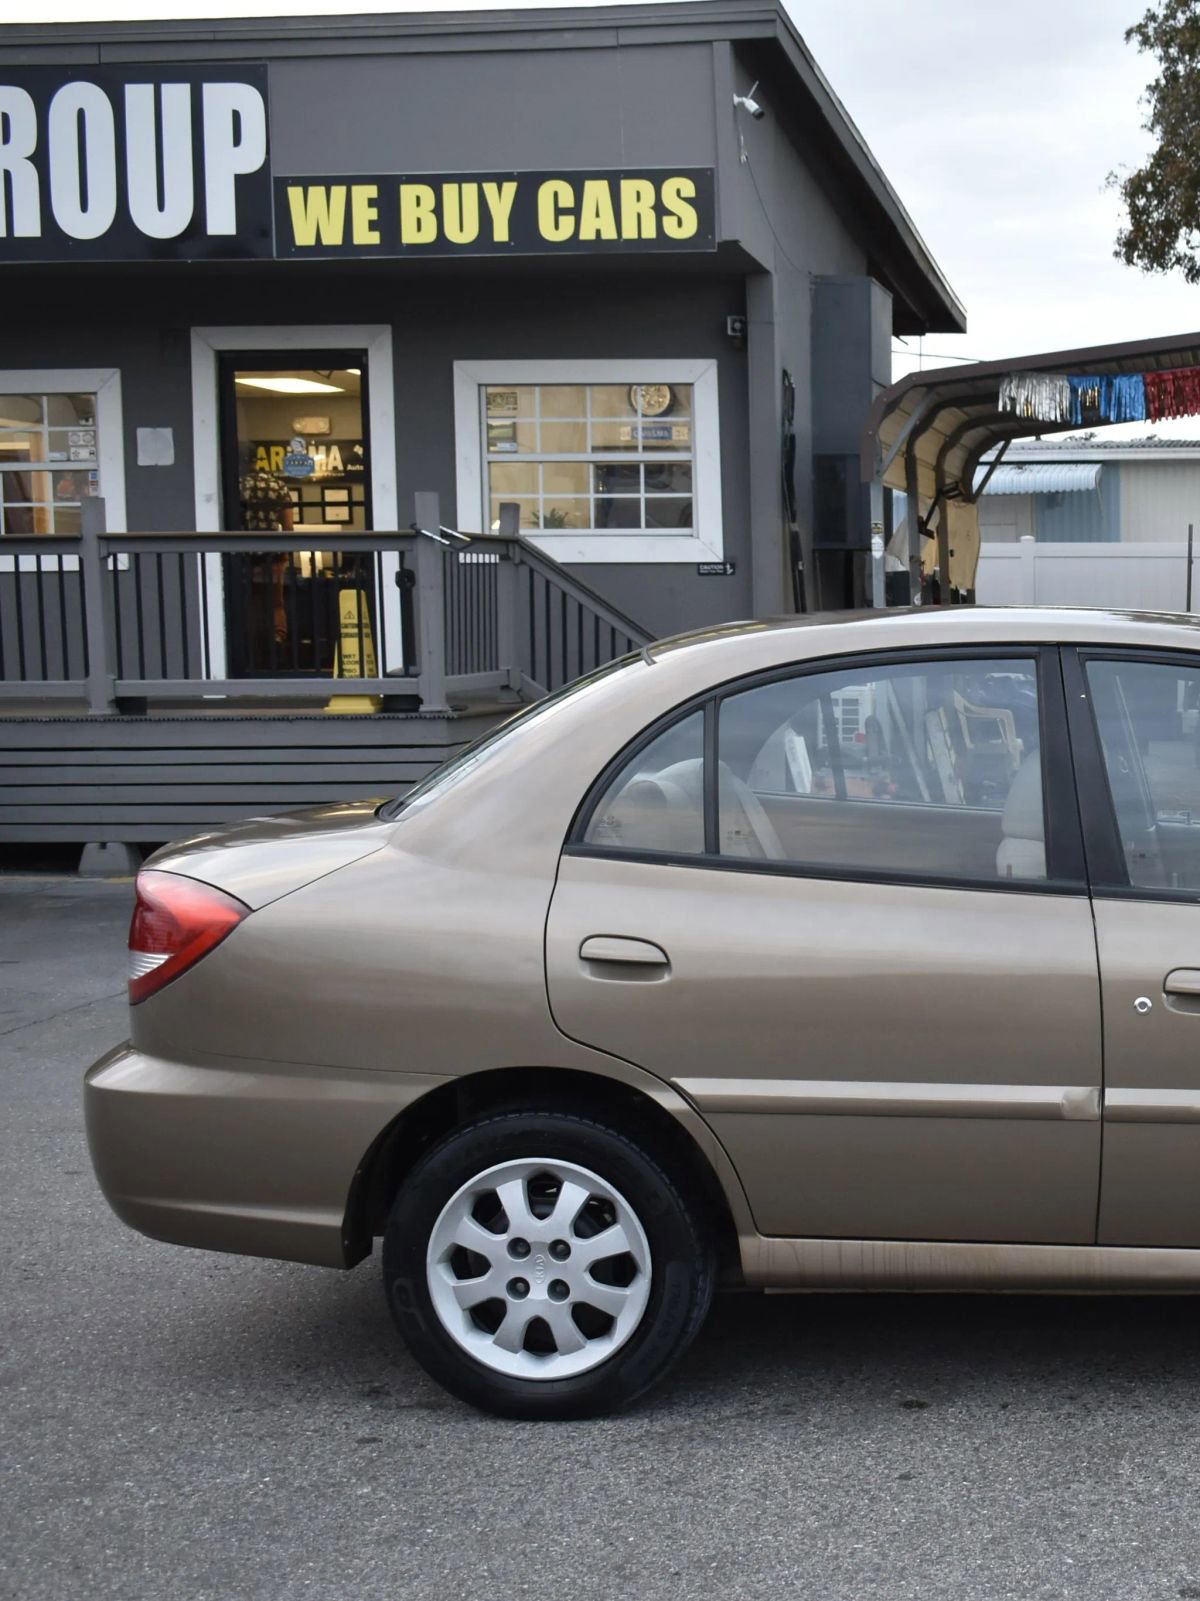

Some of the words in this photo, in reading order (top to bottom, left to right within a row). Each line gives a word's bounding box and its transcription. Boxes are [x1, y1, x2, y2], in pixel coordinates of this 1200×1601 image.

[287, 184, 380, 245] WE
[400, 182, 518, 244] BUY
[537, 177, 698, 241] CARS
[534, 1256, 546, 1282] KIA
